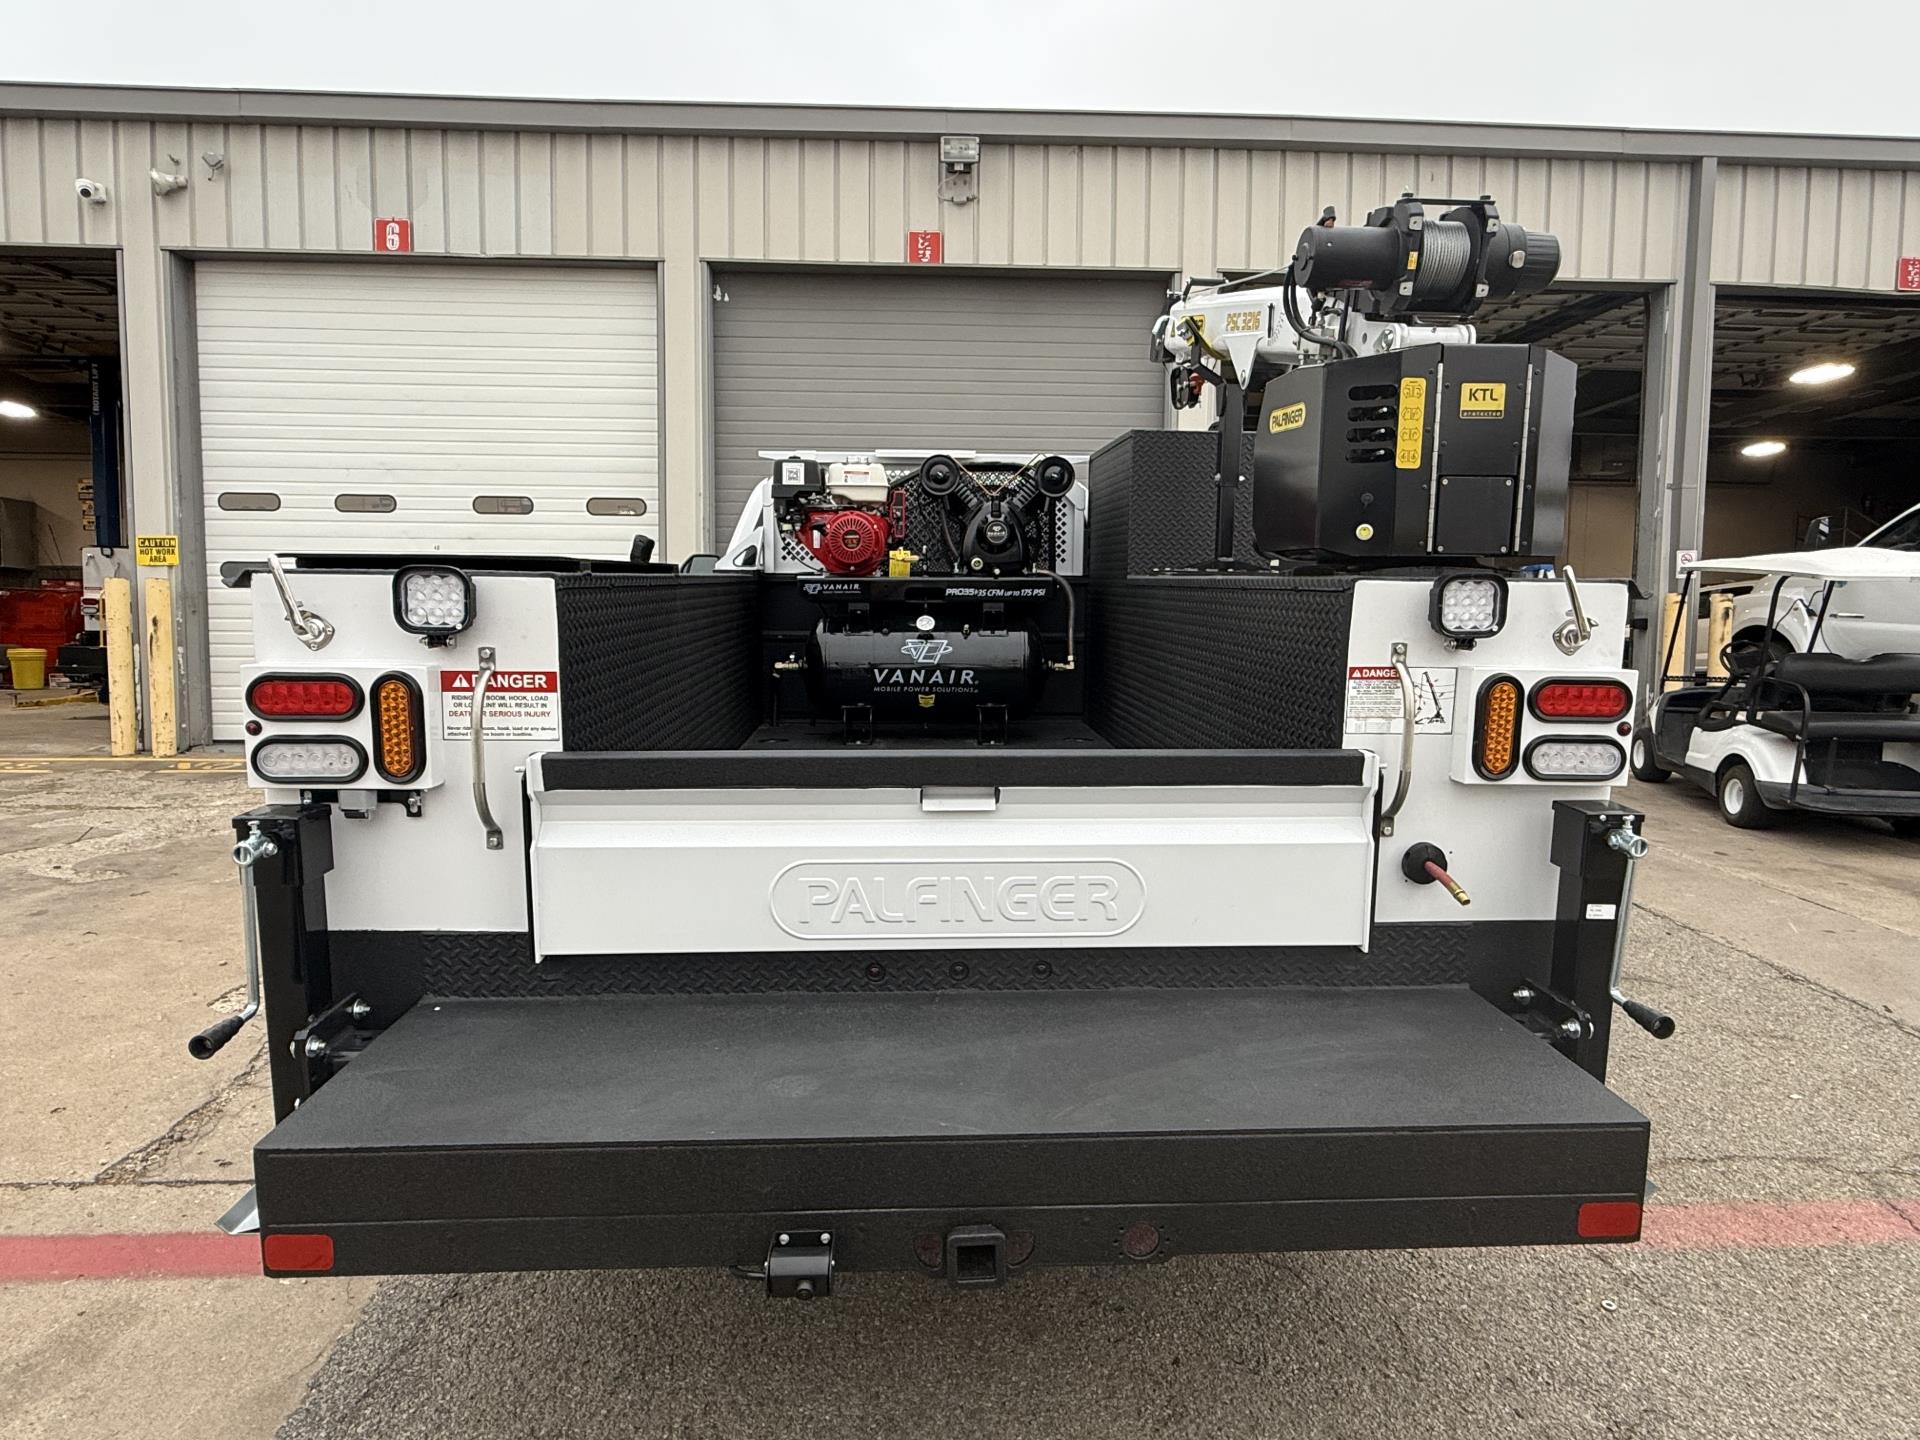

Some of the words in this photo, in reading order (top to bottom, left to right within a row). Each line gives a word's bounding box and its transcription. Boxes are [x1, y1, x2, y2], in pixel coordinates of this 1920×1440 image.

[386, 222, 400, 251] 6
[1226, 313, 1240, 331] PSC
[1469, 388, 1498, 402] KTL
[1272, 408, 1303, 430] PALFINGER
[140, 539, 176, 547] CAUTION
[873, 668, 975, 685] VANAIR
[1363, 669, 1399, 677] DANGE
[798, 875, 1119, 924] PALFINGER
